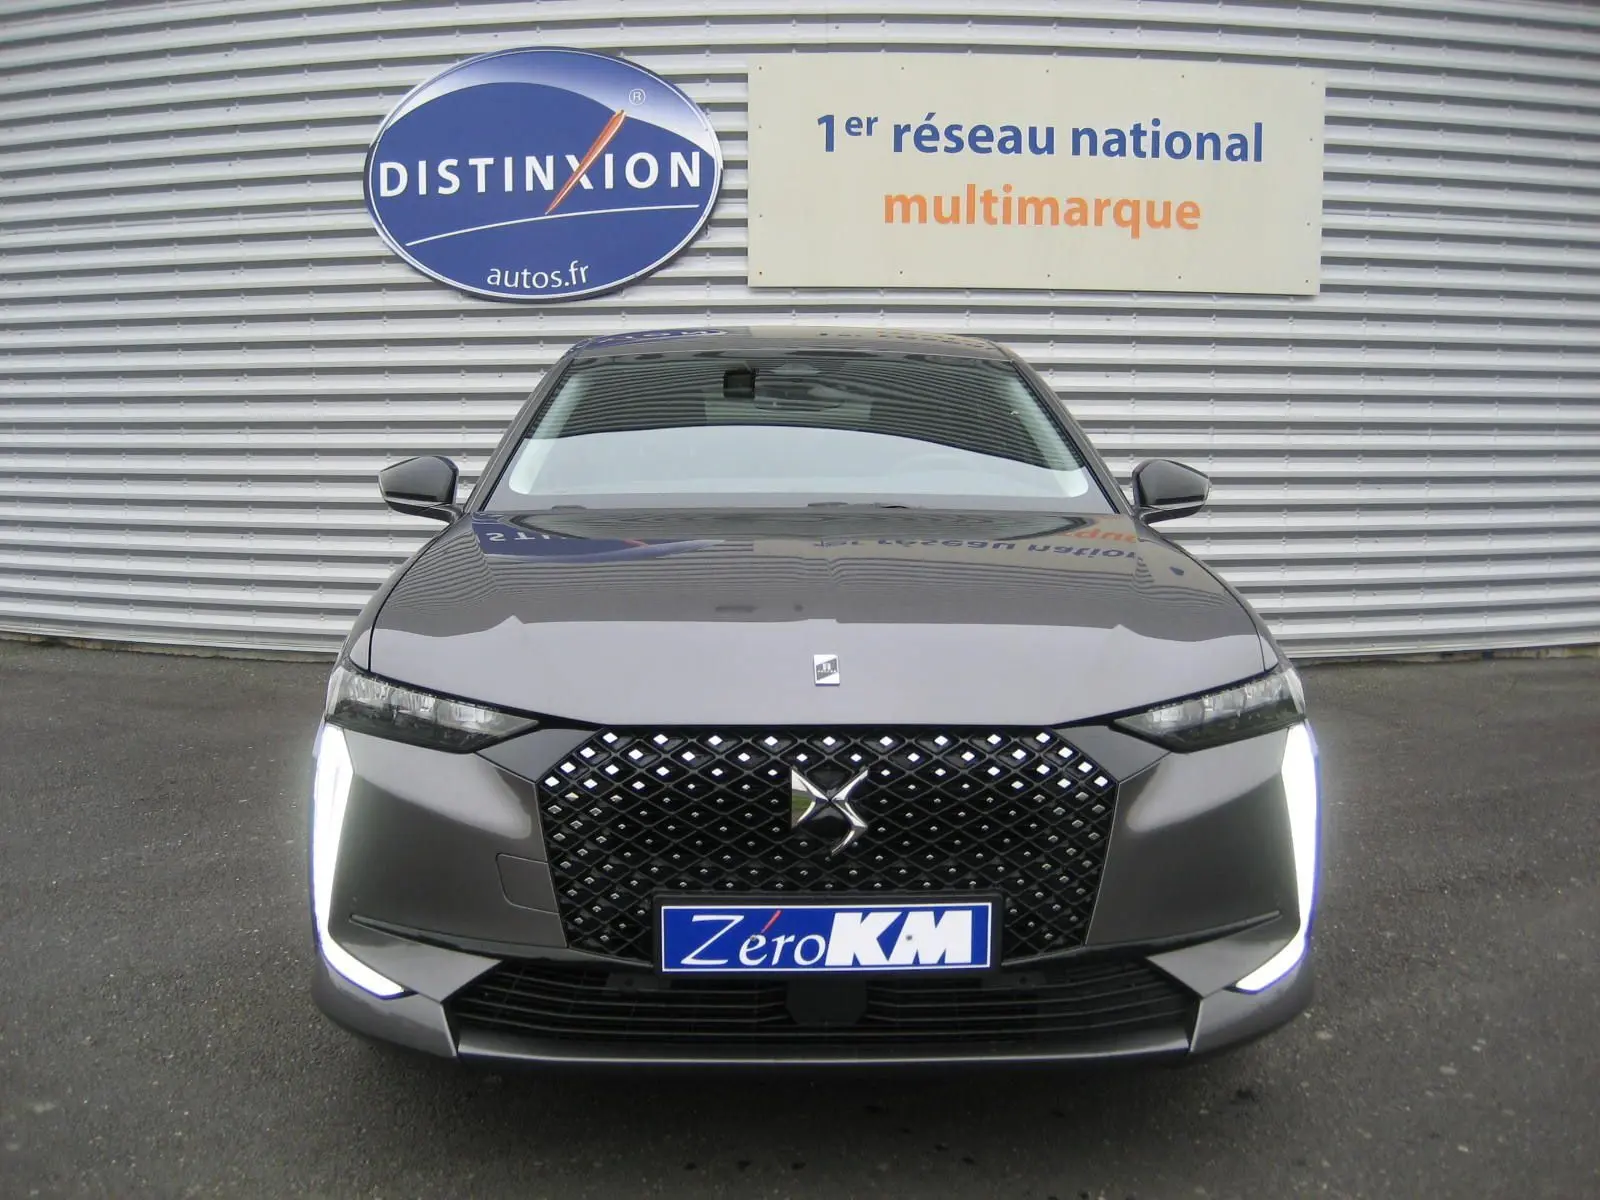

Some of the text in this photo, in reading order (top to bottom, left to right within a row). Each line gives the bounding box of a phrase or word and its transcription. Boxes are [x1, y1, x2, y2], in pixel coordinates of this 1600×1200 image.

[817, 112, 1263, 163] 1er réseau national
[379, 150, 701, 198] DISTINXION
[884, 183, 1201, 240] multimarque
[486, 260, 589, 289] autos.fr
